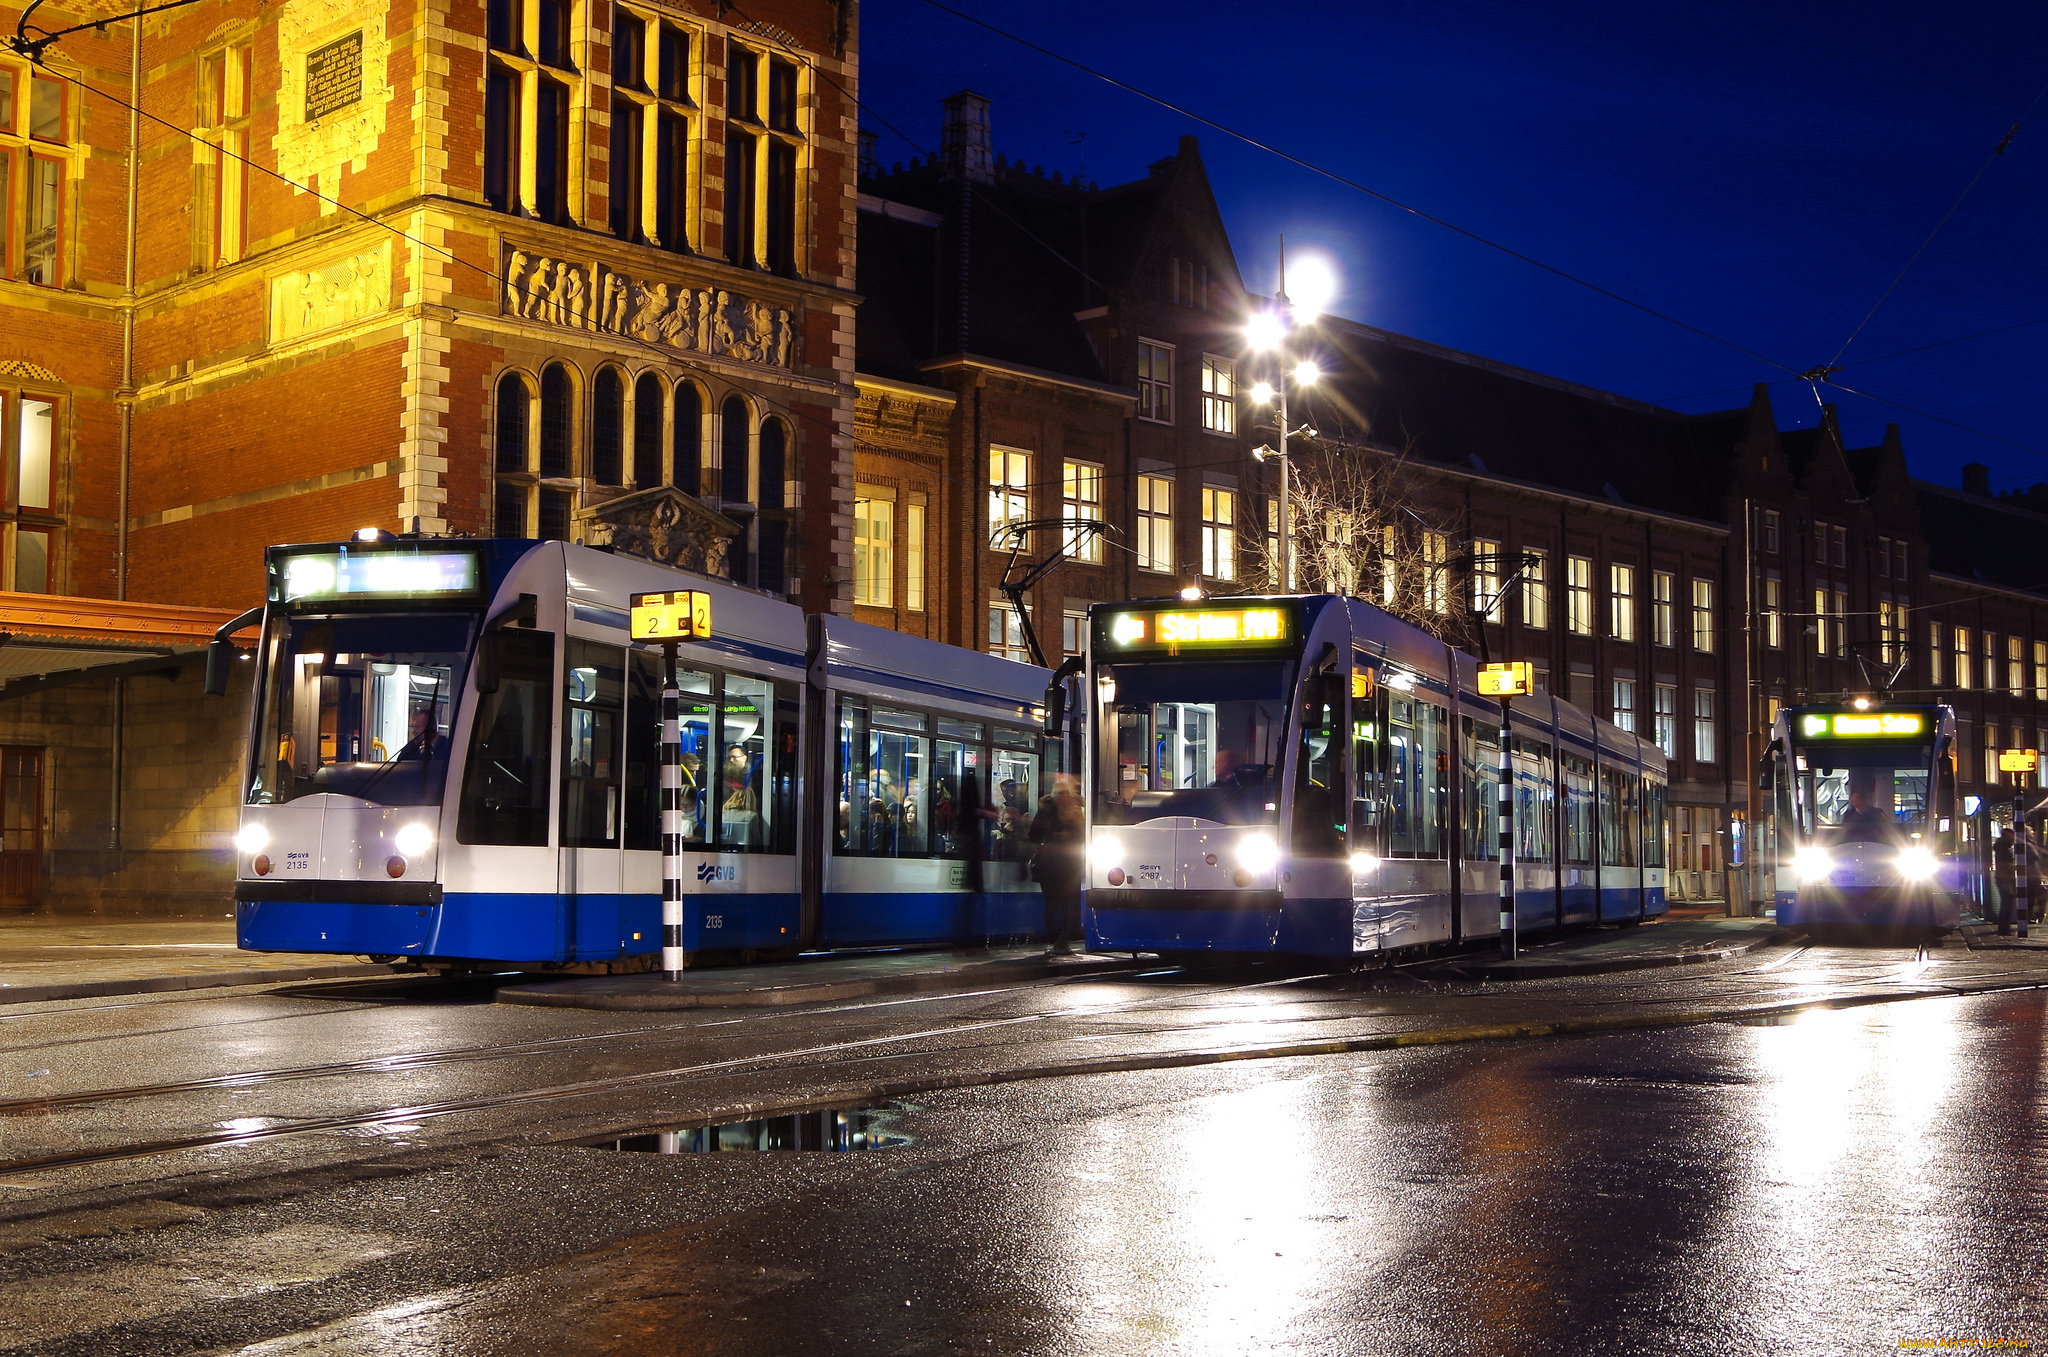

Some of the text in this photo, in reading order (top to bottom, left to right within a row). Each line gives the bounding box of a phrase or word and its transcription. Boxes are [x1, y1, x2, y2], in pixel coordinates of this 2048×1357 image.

[648, 617, 659, 634] 2
[697, 608, 705, 630] 2
[1163, 614, 1236, 640] Station
[1245, 611, 1278, 638] RAI
[1492, 679, 1500, 692] 3
[286, 861, 308, 870] 2135
[716, 866, 735, 881] GVB
[705, 915, 723, 929] 2135
